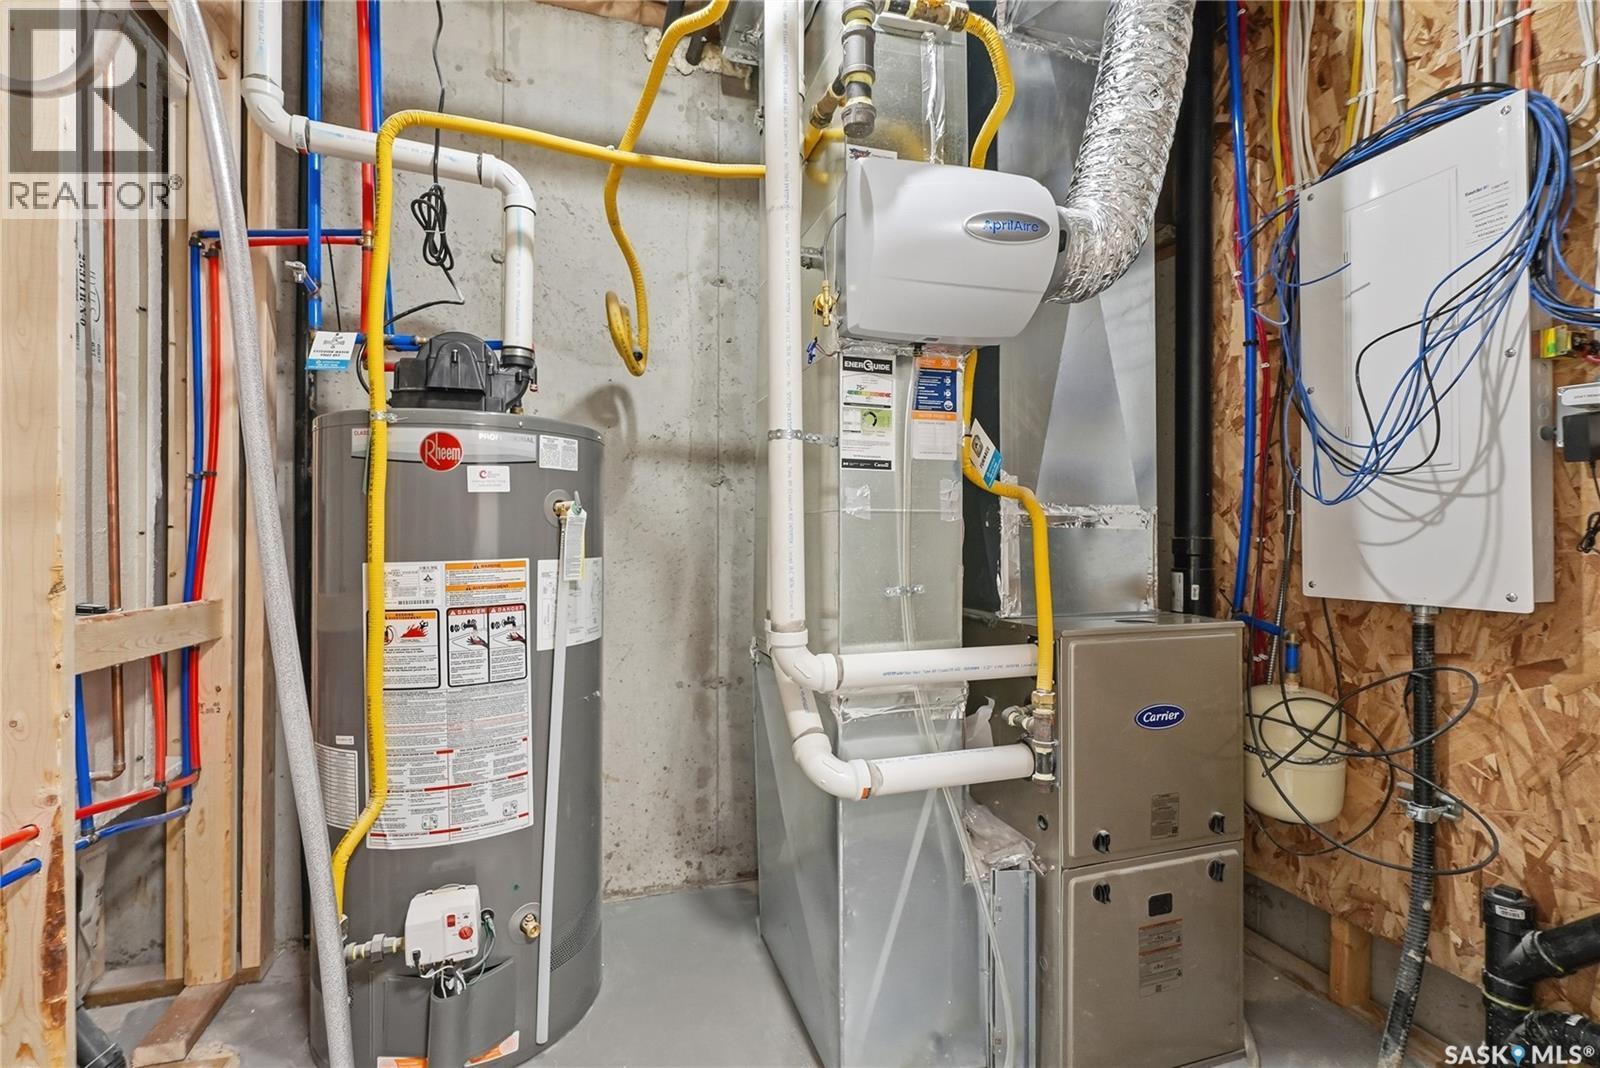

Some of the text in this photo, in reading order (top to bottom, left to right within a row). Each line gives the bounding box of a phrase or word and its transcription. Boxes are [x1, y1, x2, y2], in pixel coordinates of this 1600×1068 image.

[983, 219, 1040, 234] AprilAire
[844, 360, 891, 371] ENERGUIDE
[424, 433, 462, 465] Rheem
[1143, 711, 1180, 723] Carrier
